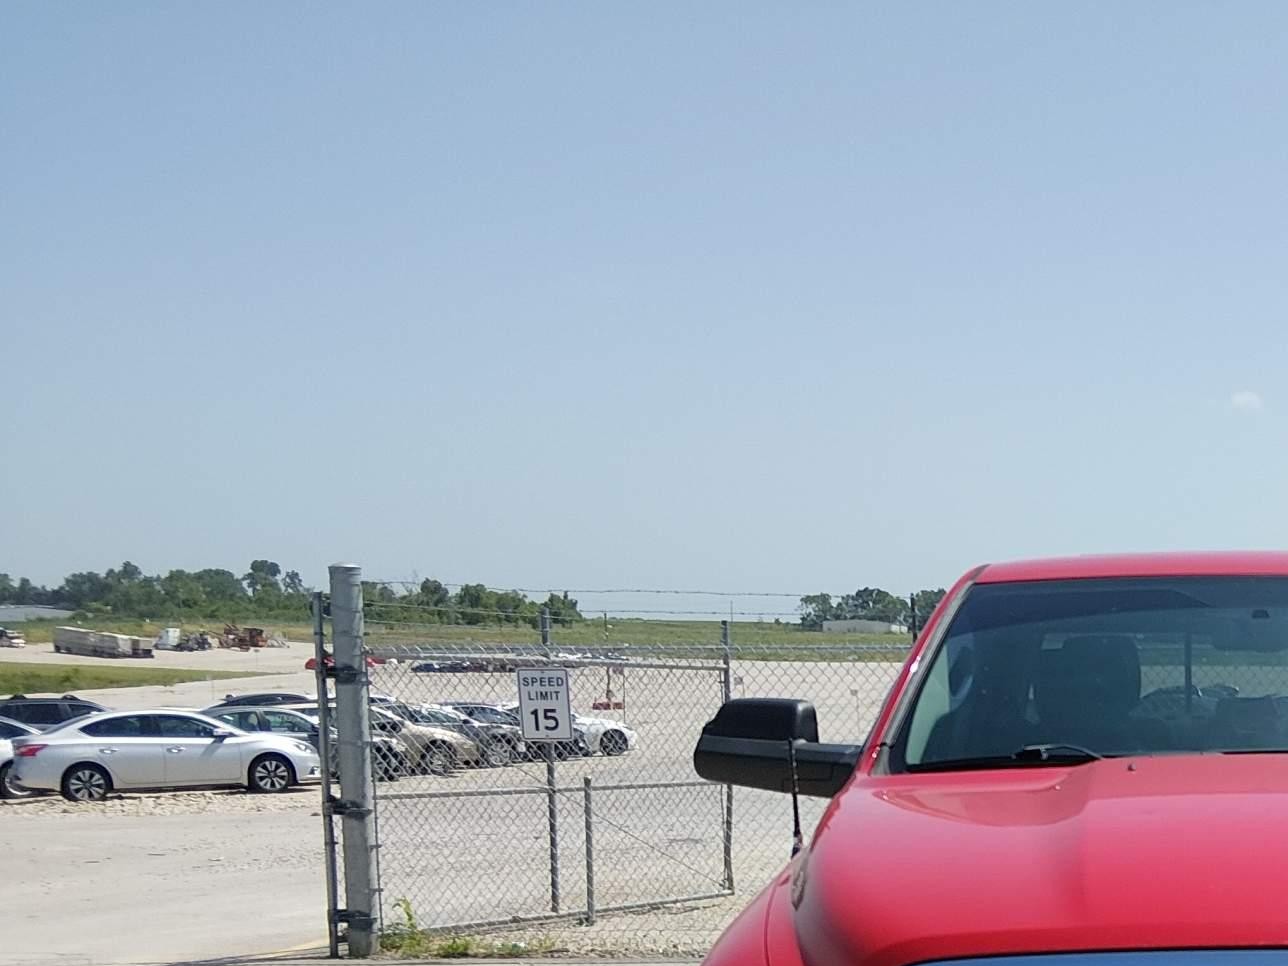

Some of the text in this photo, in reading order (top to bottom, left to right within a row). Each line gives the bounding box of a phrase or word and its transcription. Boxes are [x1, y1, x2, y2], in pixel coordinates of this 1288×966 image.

[522, 677, 564, 687] SPEED
[528, 691, 560, 701] LIMIT
[530, 708, 559, 731] 15
